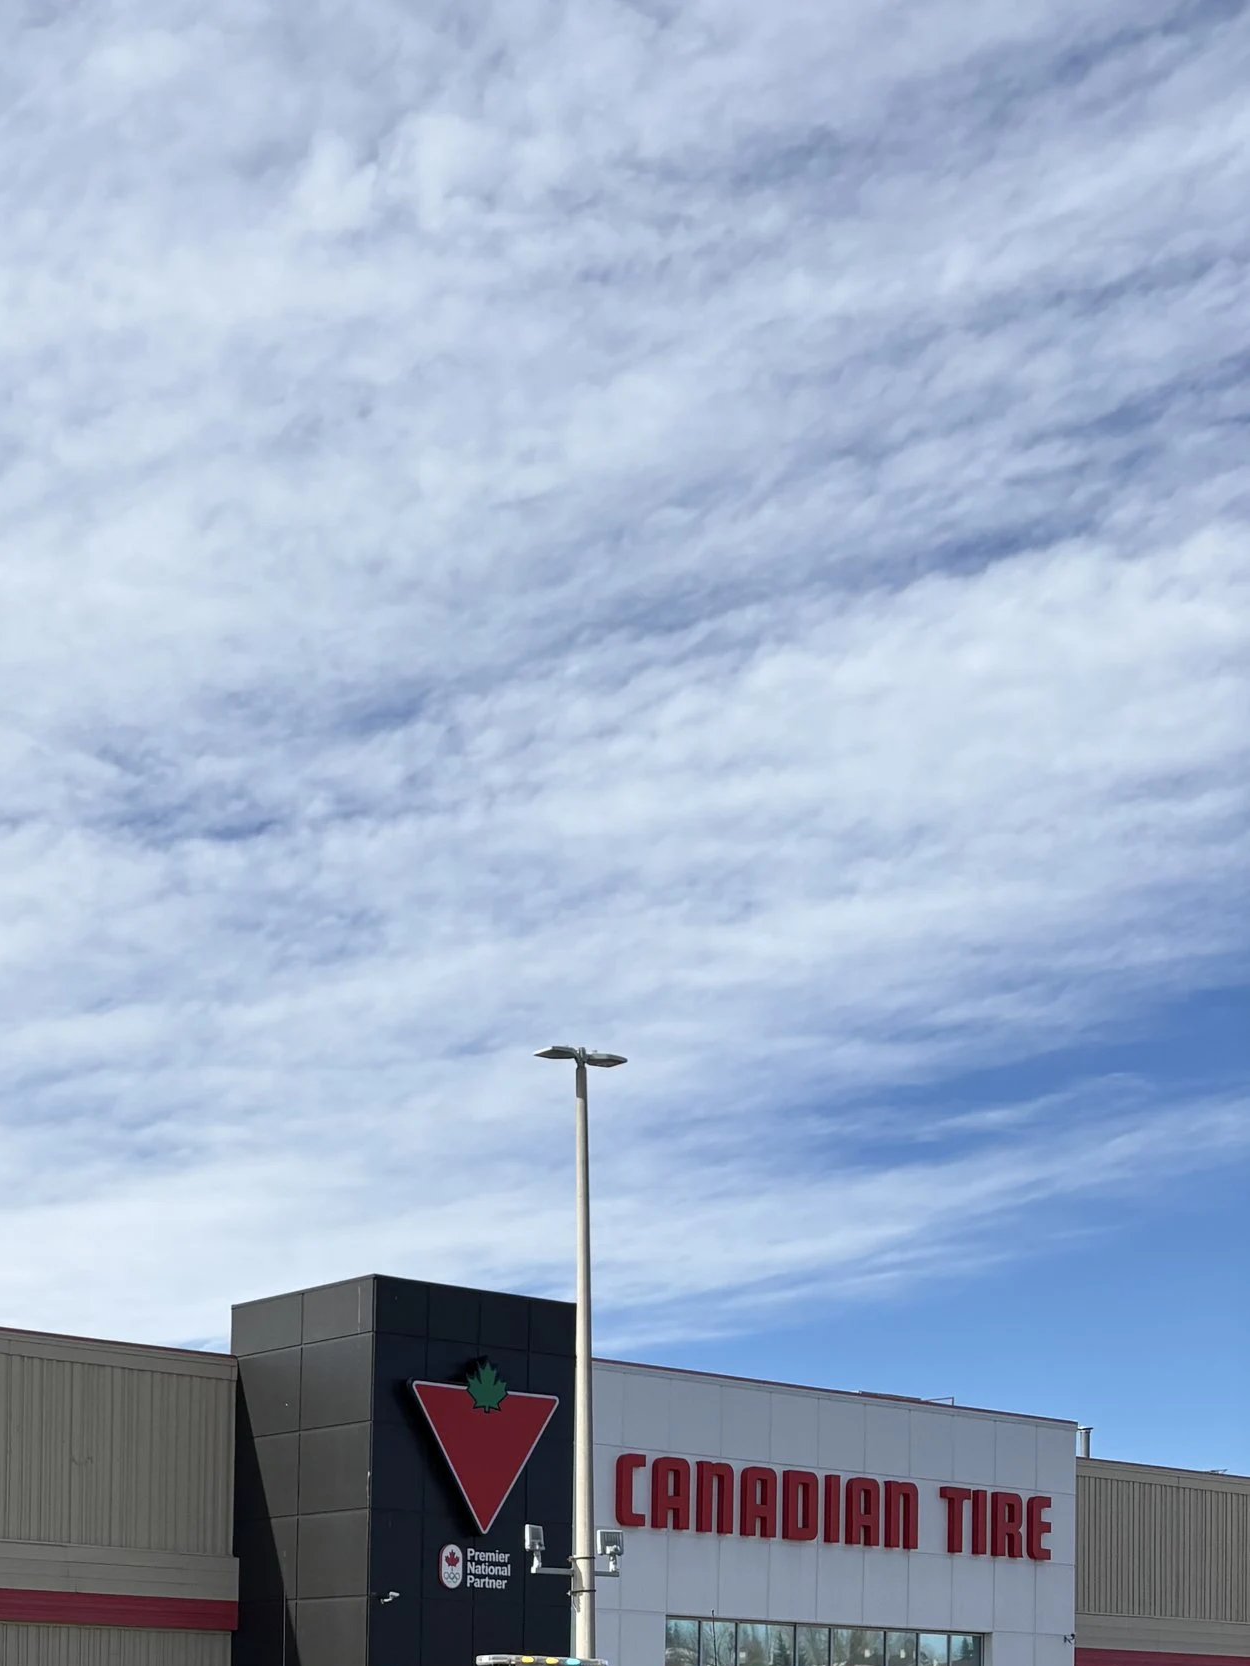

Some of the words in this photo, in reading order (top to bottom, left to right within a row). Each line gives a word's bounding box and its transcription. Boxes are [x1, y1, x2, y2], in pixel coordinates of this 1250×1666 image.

[615, 1452, 919, 1550] CANADIAN
[939, 1485, 1052, 1561] TIRE
[466, 1548, 510, 1563] Premier
[466, 1562, 511, 1577] National
[466, 1575, 507, 1589] Partner
